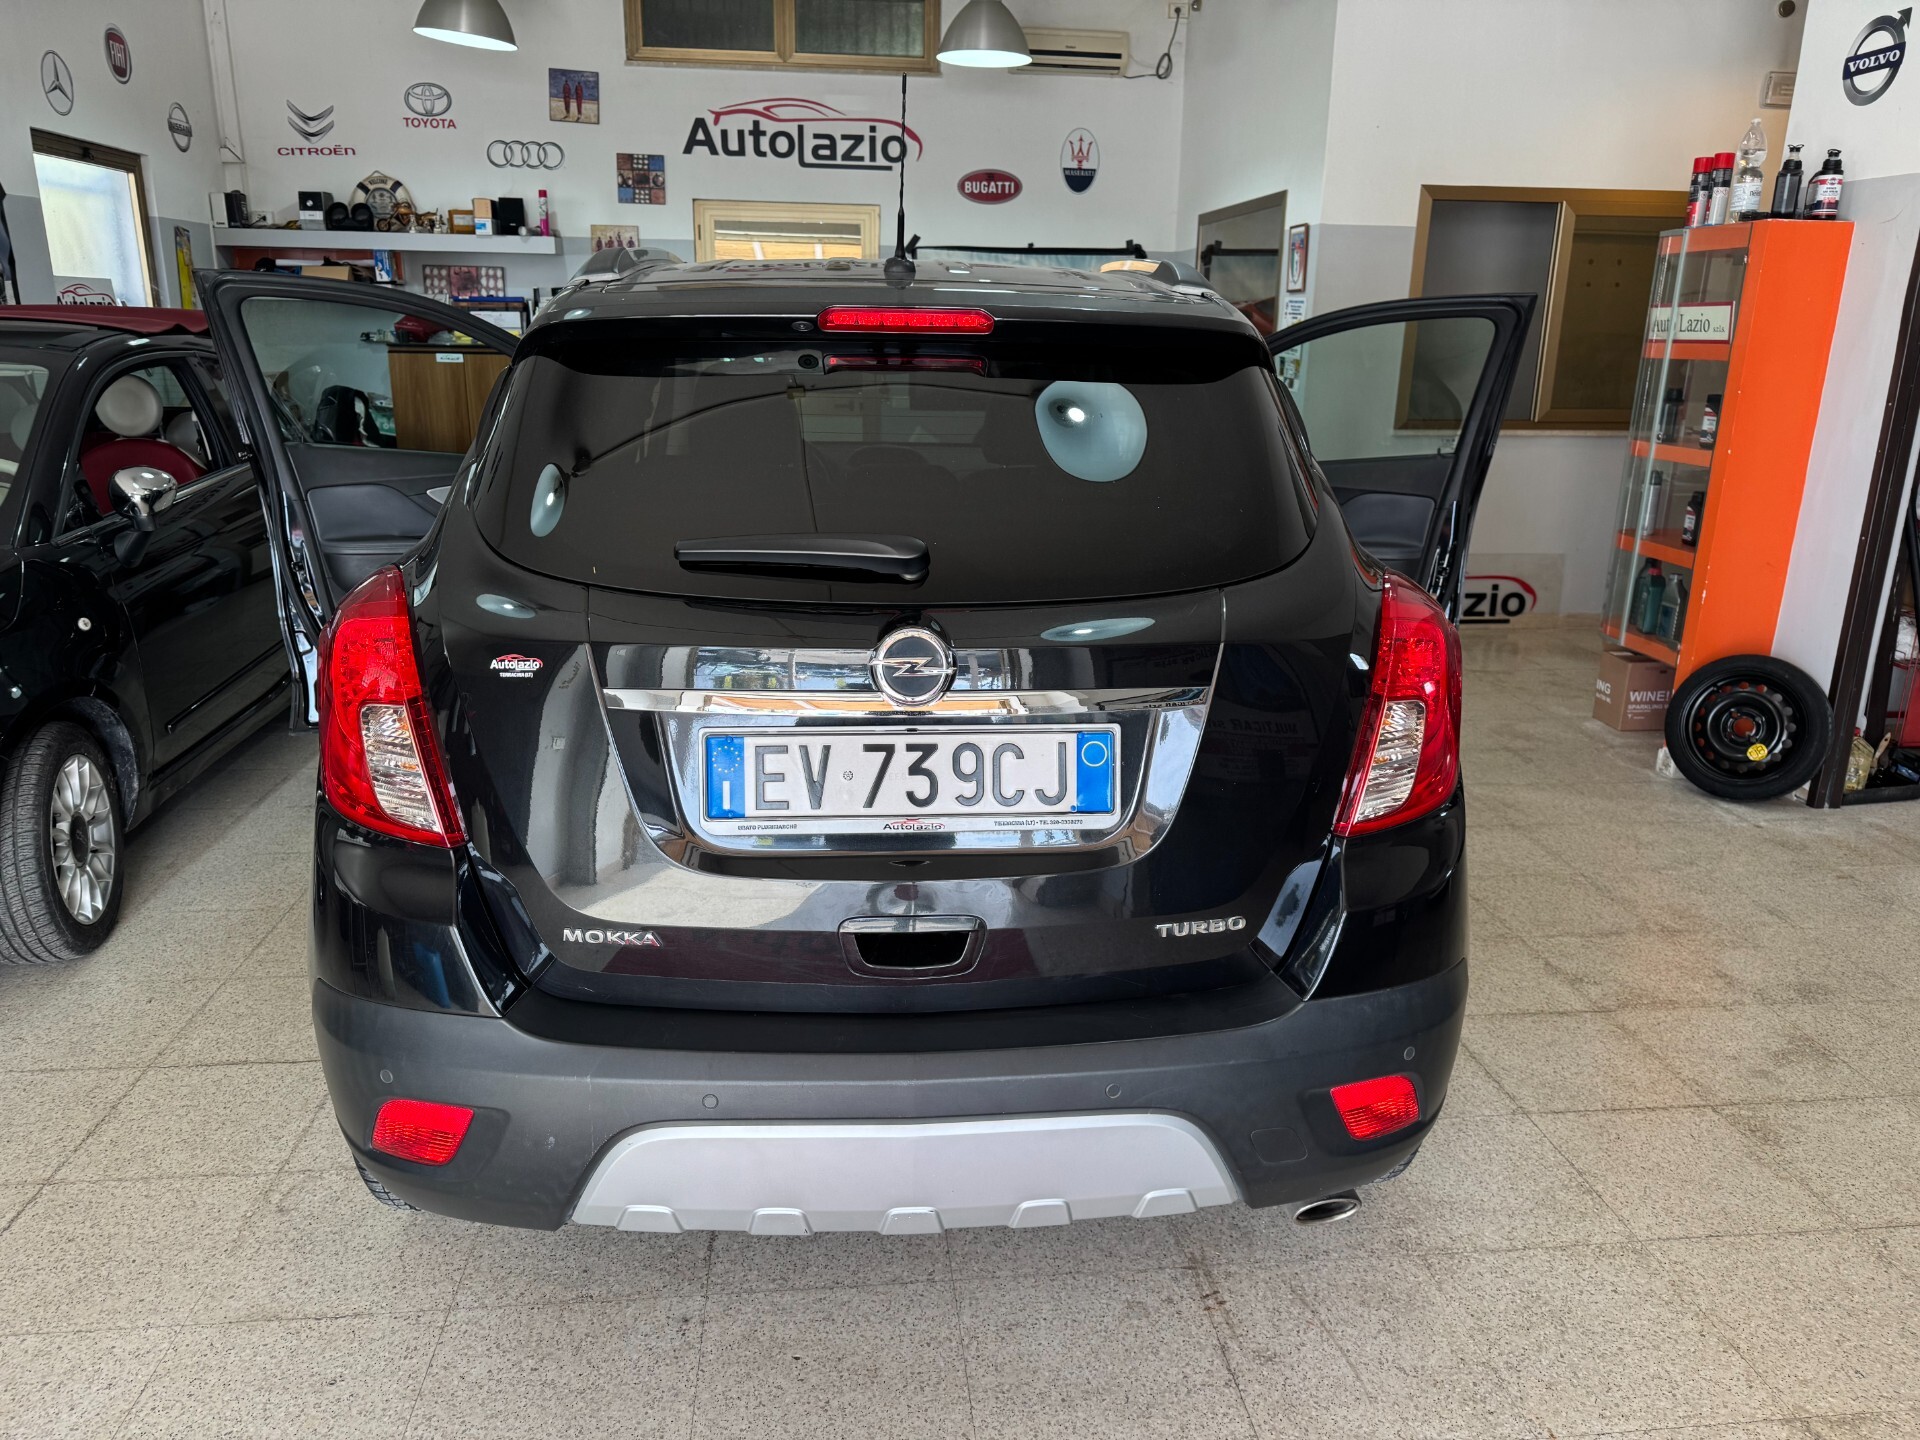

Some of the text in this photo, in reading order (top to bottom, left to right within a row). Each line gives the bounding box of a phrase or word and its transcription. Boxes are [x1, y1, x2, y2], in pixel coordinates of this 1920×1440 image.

[109, 40, 126, 69] FIAT
[1847, 49, 1901, 73] VOLVO
[403, 117, 457, 130] TOYOTA
[1064, 169, 1097, 177] MASERATI
[964, 181, 1015, 194] BUGATTI
[1652, 318, 1676, 333] Aut
[1679, 313, 1710, 333] Lazio
[754, 744, 832, 811] EV
[862, 741, 1067, 808] 739CJ
[1155, 915, 1247, 938] TURBO
[562, 927, 662, 947] MOKKA
